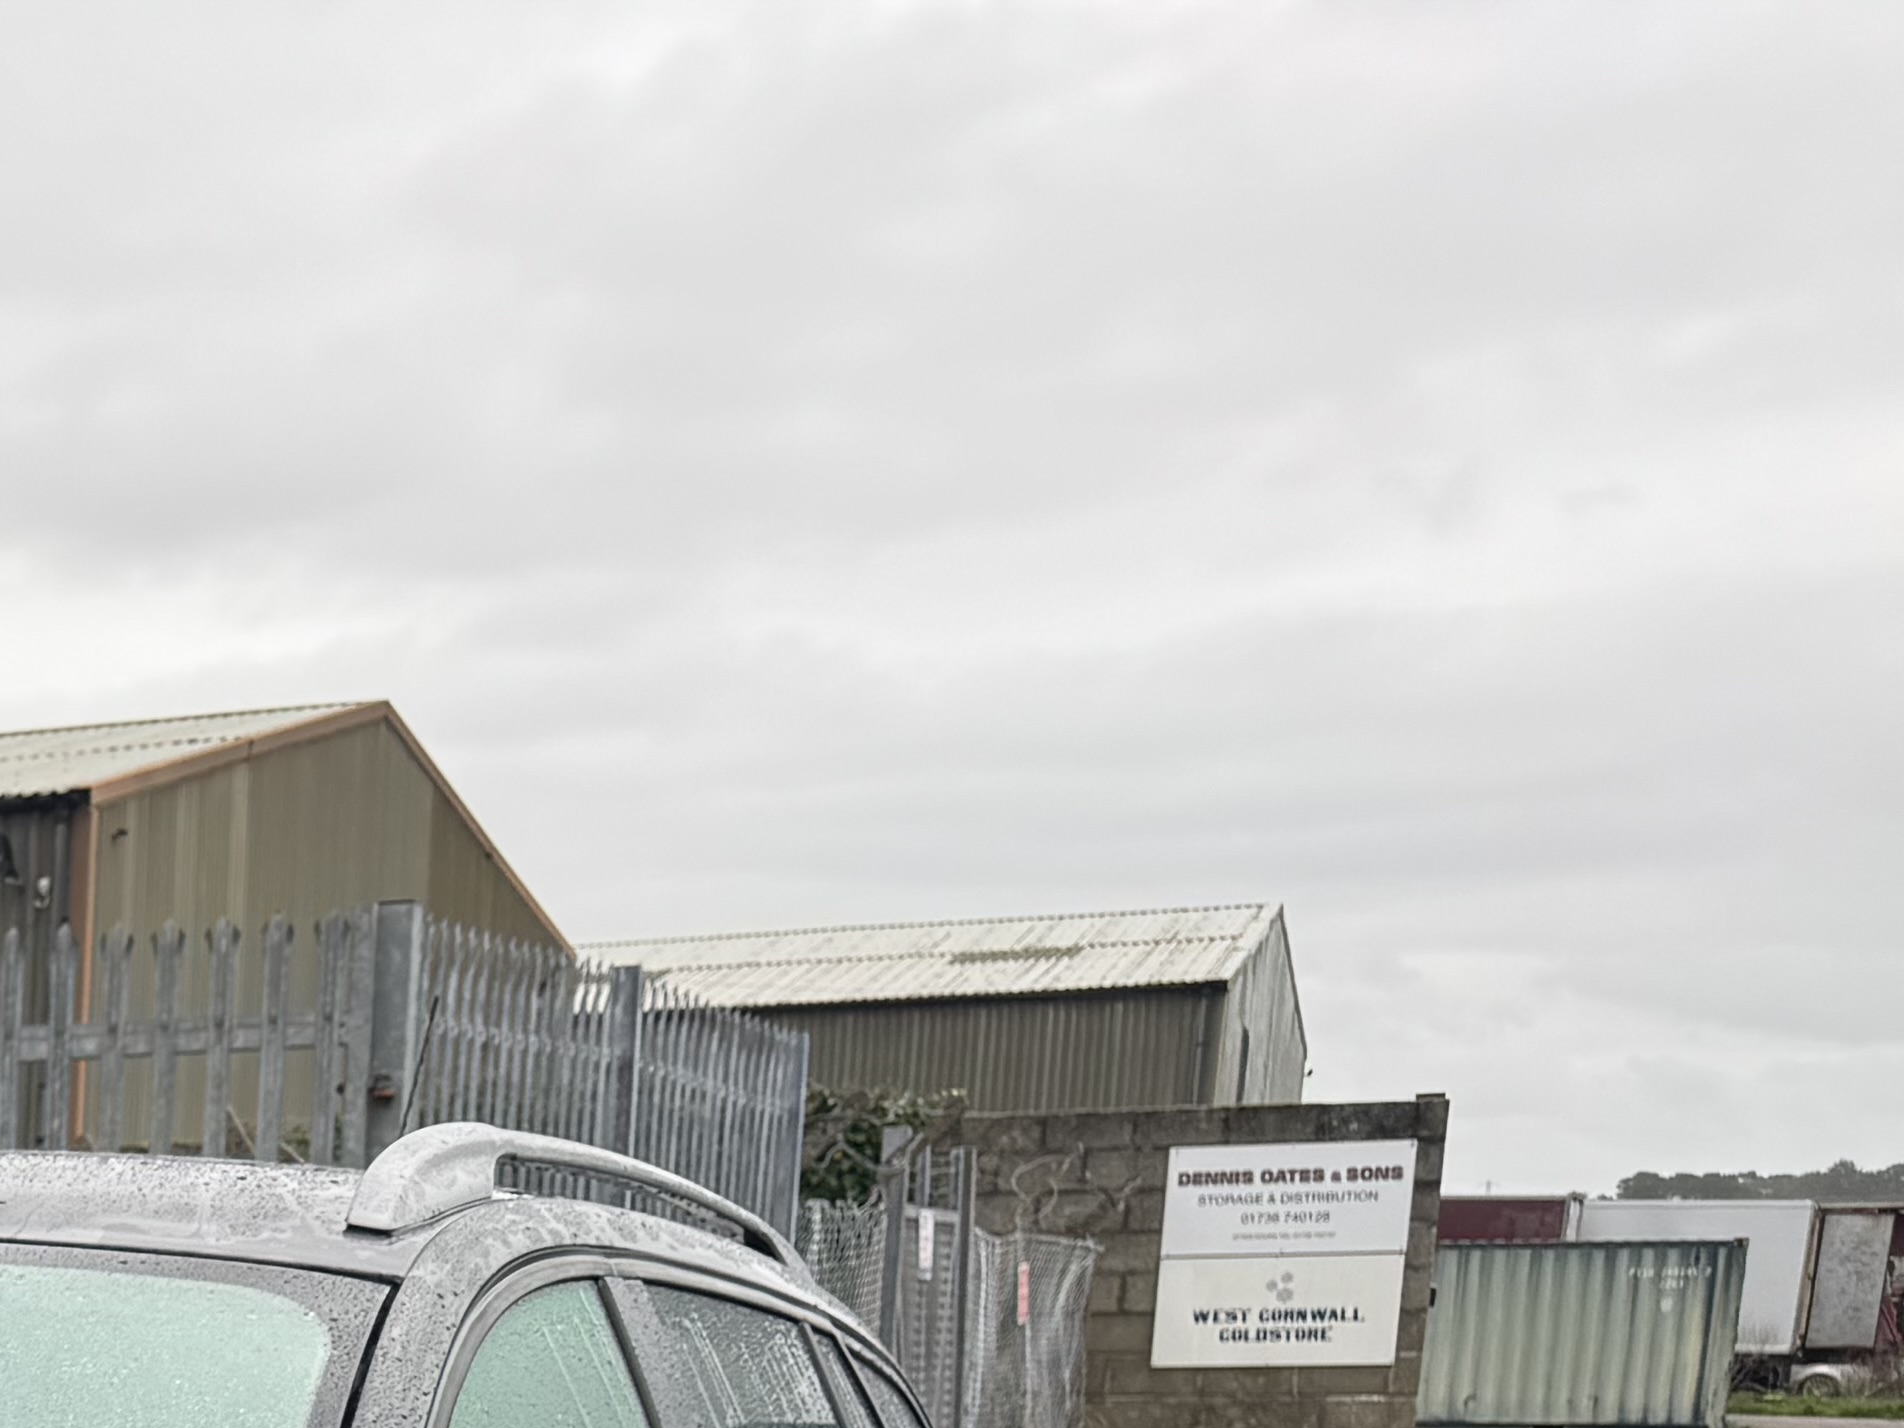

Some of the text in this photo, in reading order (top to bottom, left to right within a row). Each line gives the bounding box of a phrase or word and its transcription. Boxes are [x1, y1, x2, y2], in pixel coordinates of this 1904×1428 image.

[1178, 1170, 1253, 1187] DENNIS
[1260, 1168, 1325, 1184] OATES
[1346, 1165, 1404, 1182] SONS
[1197, 1191, 1264, 1207] STORAGE
[1280, 1189, 1379, 1205] DISTRIBUTION
[1192, 1306, 1365, 1325] WEST CORNWALL
